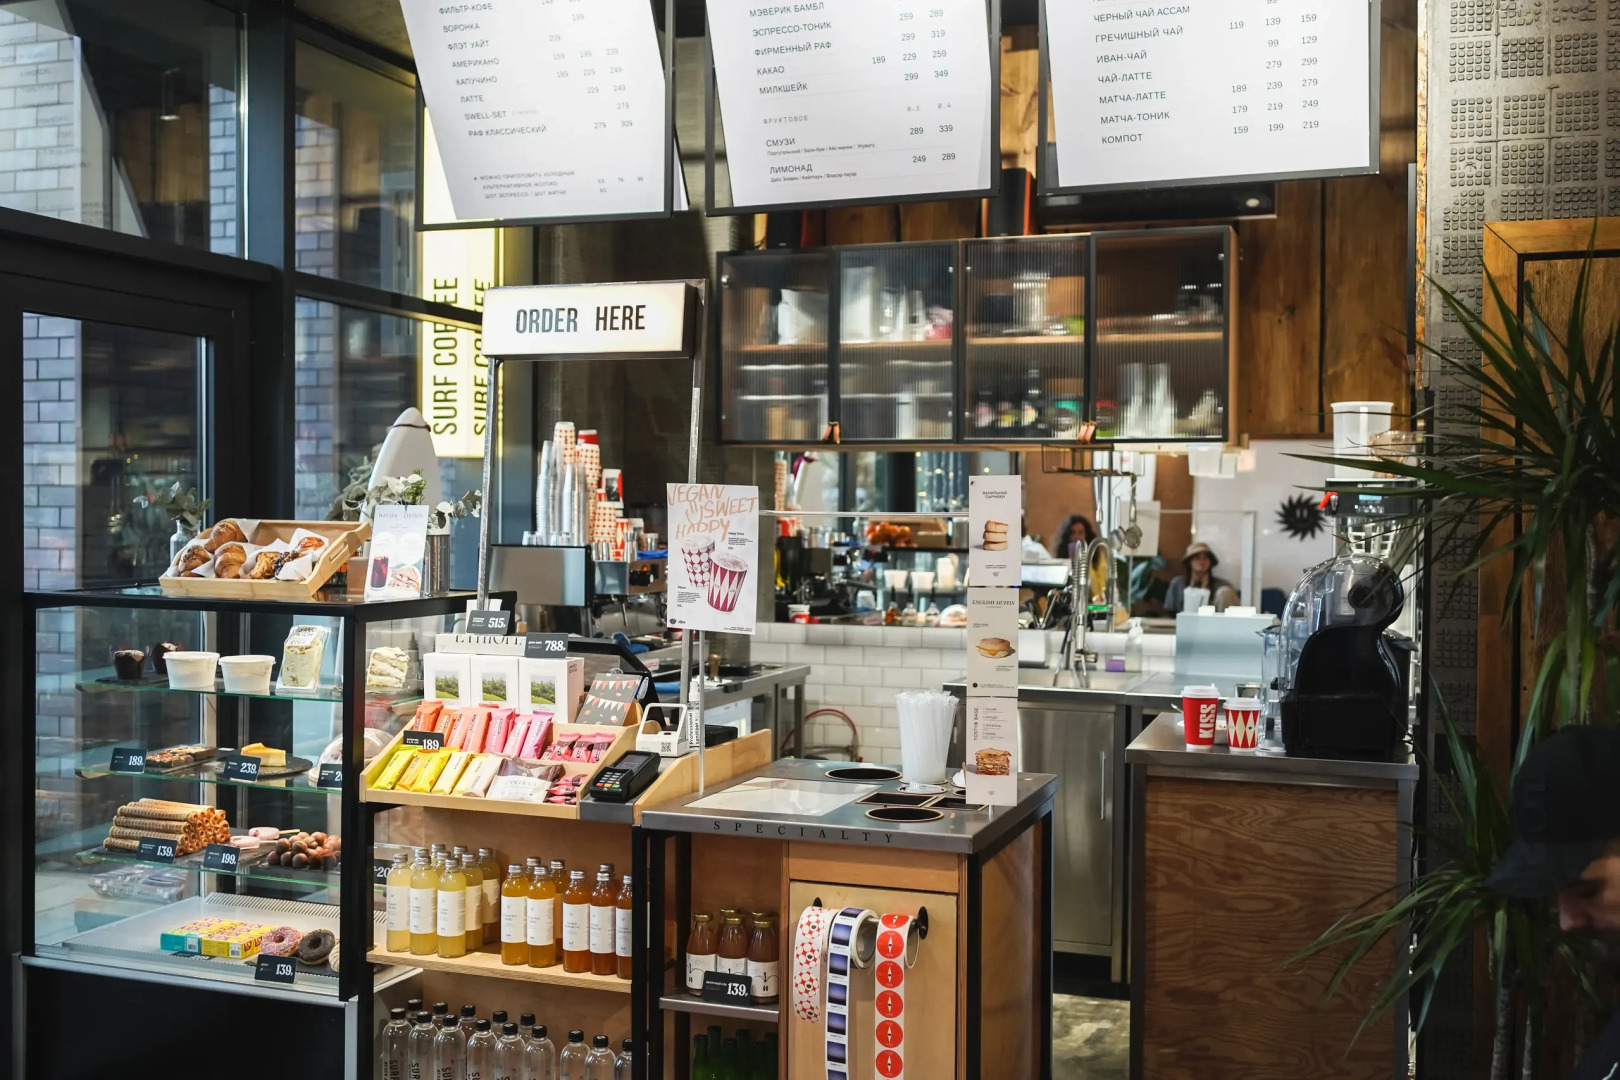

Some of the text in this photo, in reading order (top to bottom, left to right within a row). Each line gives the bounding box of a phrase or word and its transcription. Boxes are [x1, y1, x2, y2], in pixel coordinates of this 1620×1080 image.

[438, 2, 494, 15] ФИЛЬТР-КОФЕ
[750, 2, 824, 18] МЭВЕРИК БАМБЛ
[1093, 6, 1190, 23] ЧЕРНЫЙ ЧАЙ АССАМ
[443, 24, 480, 33] ВОРОНКА
[752, 9, 944, 37] ЭСПРЕССО-ТОНИК 259 289
[1095, 13, 1317, 43] ГРЕЧИШНЫЙ ЧАЙ 119 139 159
[448, 42, 468, 50] ФЛЭТ
[470, 40, 489, 49] УАЙТ
[754, 29, 946, 56] ФИРМЕННЫЙ РАФ 289 319
[1096, 36, 1318, 64] ИВАН-ЧАЙ 99 129
[452, 57, 500, 68] АМЕРИКАНО
[757, 49, 947, 76] КАКАО 189 229 259
[1098, 57, 1318, 84] ЧАЙ-ЛАТТЕ 279 299
[456, 76, 498, 86] КАПУЧИНО
[759, 69, 949, 94] МИЛКШЕЙК 299 349
[1099, 78, 1318, 104] МАТЧА-ЛАТТЕ 189 239 279
[460, 95, 484, 103] ЛАТТЕ
[464, 111, 507, 121] SWELL-SET
[763, 115, 808, 124] ФРУКТОВОЕ
[1100, 99, 1319, 125] МАТЧА-ТОНИК 179 219 249
[468, 130, 484, 138] РАФ
[485, 124, 548, 136] КЛАССИЧЕСКИЙ
[766, 124, 954, 147] СМУЗИ 289 339
[1101, 120, 1319, 145] КОМПОТ 159 199 219
[770, 153, 956, 174] ЛИМОНАД 249 289
[516, 305, 647, 334] ORDER HERE
[433, 375, 458, 435] SURF
[668, 484, 726, 506] VEGAN
[704, 497, 758, 519] SWEET
[1199, 704, 1216, 738] KISS
[423, 739, 439, 750] 189
[713, 820, 893, 844] SPECIALTY
